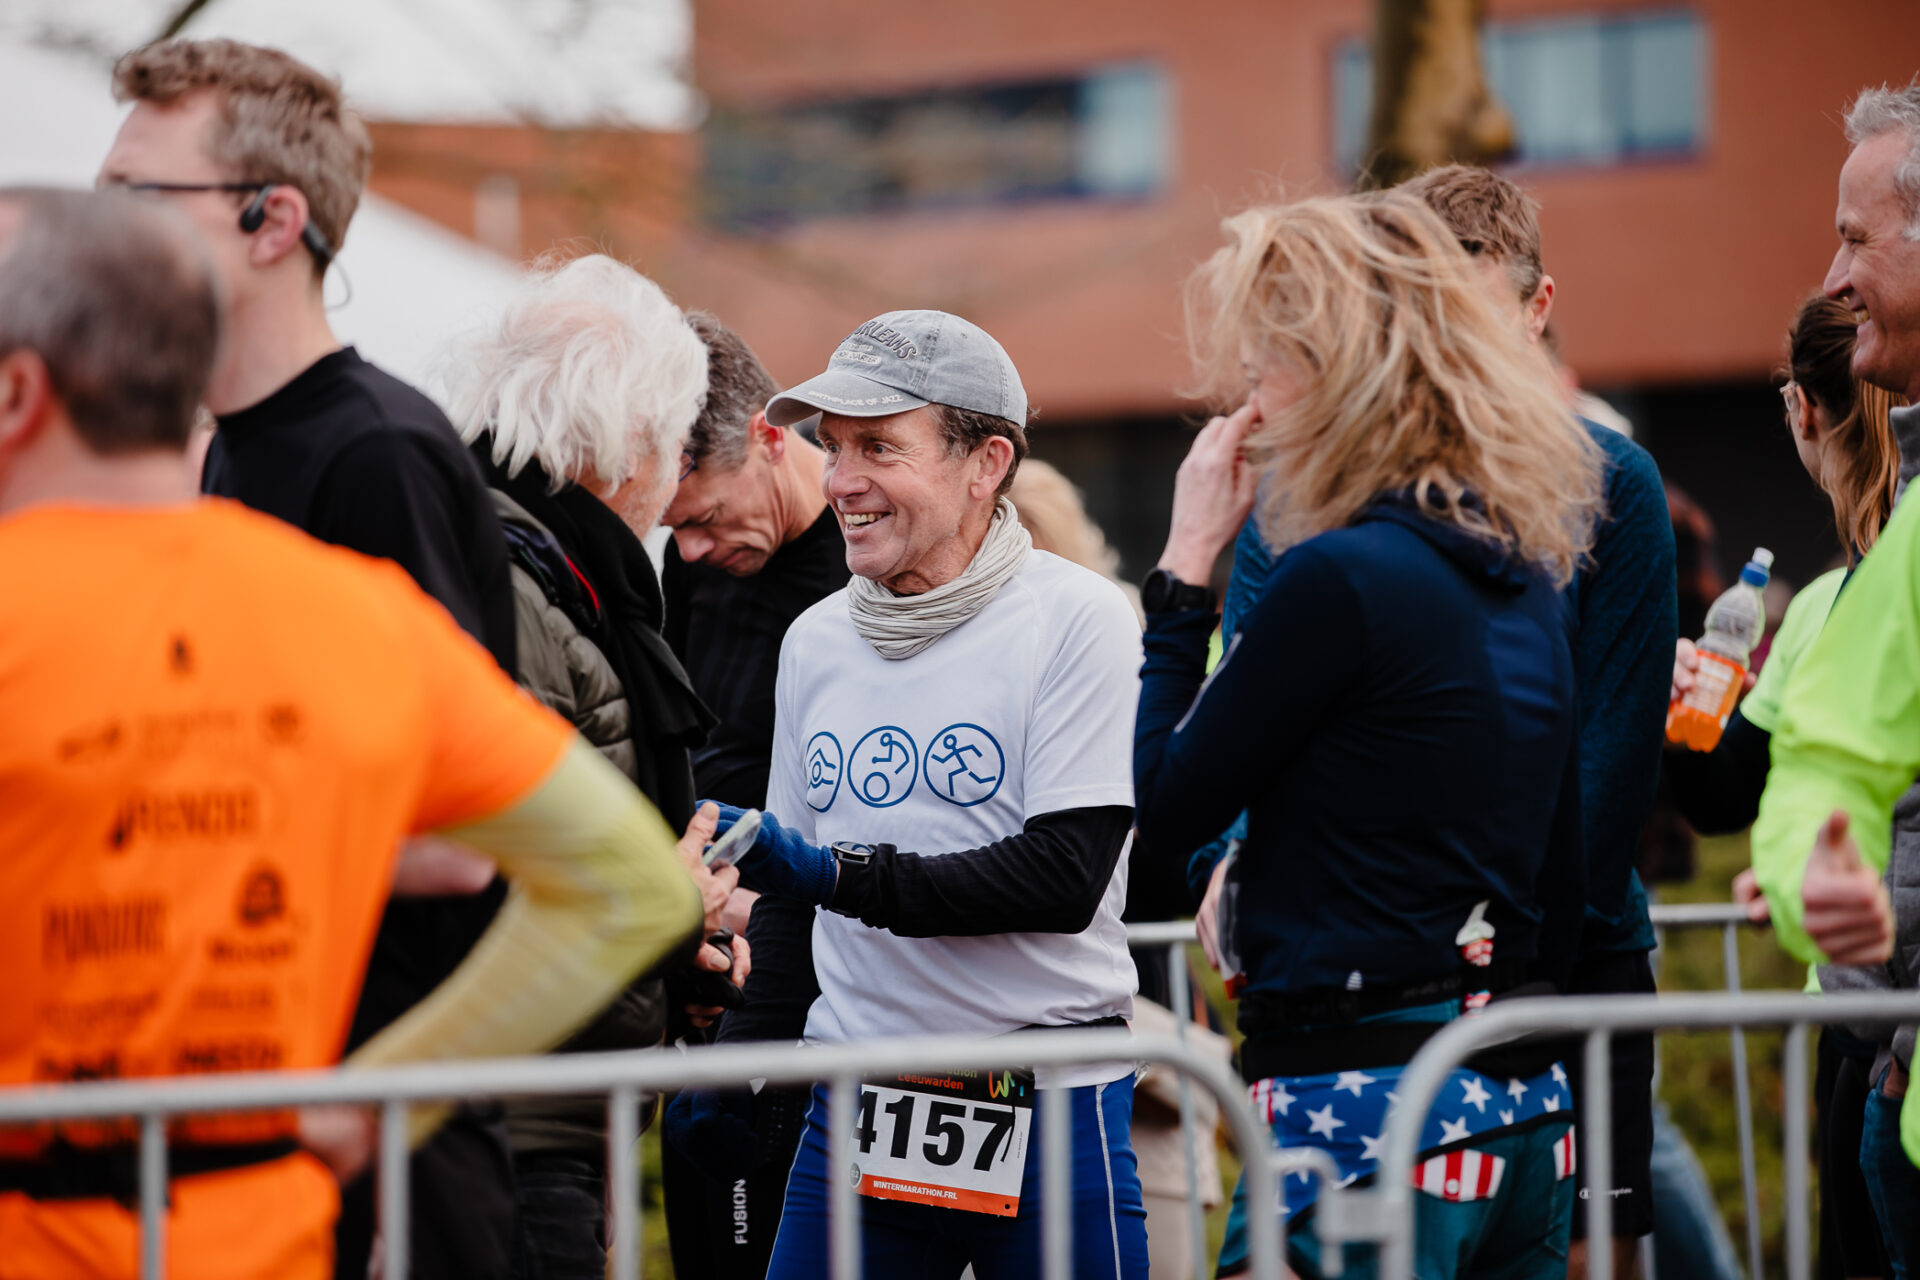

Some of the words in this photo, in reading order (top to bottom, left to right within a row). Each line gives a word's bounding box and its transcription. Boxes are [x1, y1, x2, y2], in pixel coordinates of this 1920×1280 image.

[865, 397, 878, 406] OF
[898, 1072, 964, 1091] Leeuwarden
[852, 1090, 1014, 1172] 4157
[873, 1180, 958, 1200] WINTERMARATHON.FRL
[733, 1178, 748, 1245] FUSION
